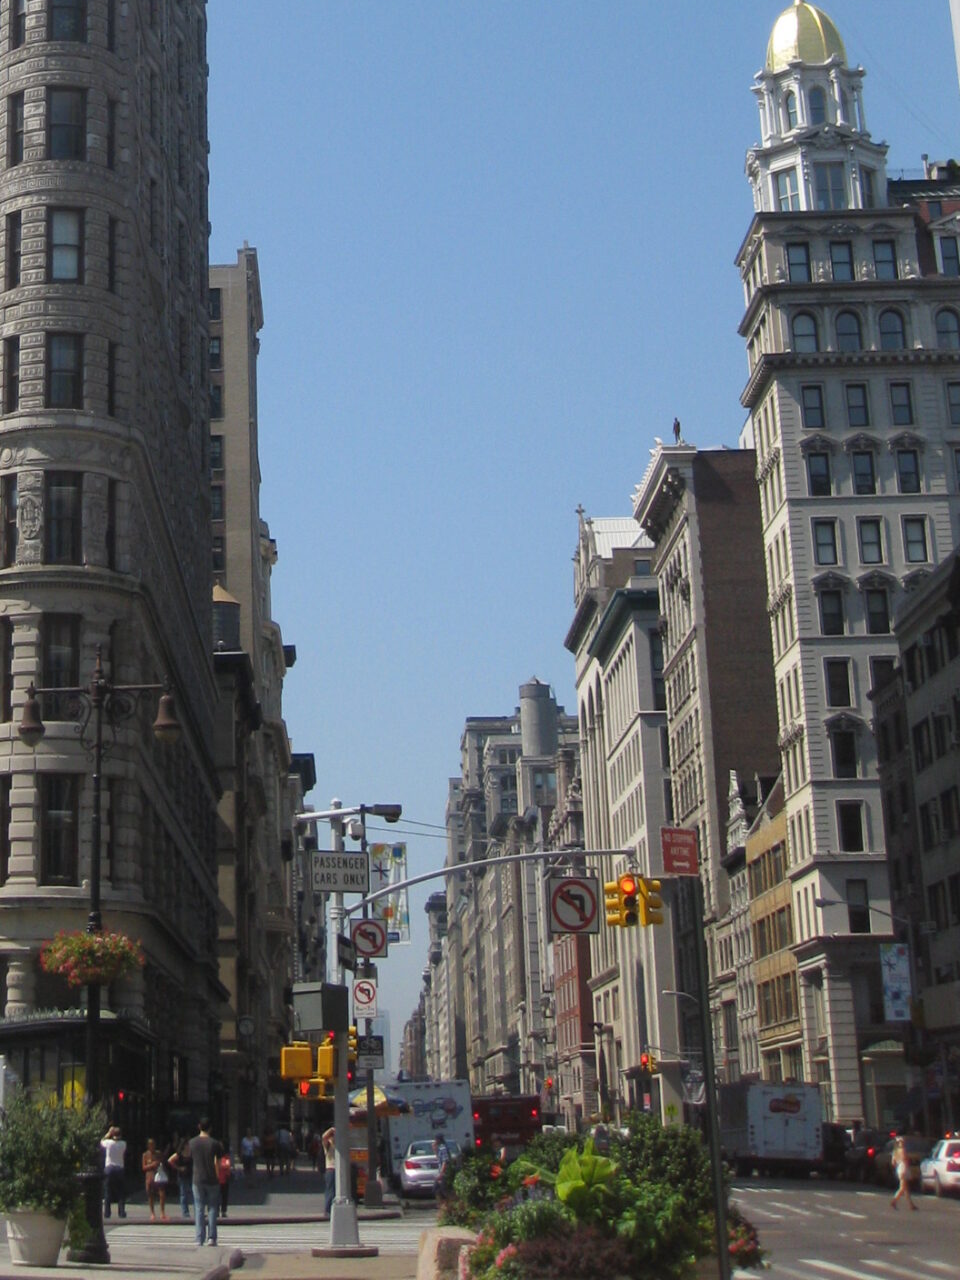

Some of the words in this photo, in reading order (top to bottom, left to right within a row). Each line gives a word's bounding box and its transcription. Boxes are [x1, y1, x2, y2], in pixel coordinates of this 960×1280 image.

[314, 856, 366, 870] PASSENGER
[314, 872, 338, 885] CARS
[343, 873, 366, 886] ONLY
